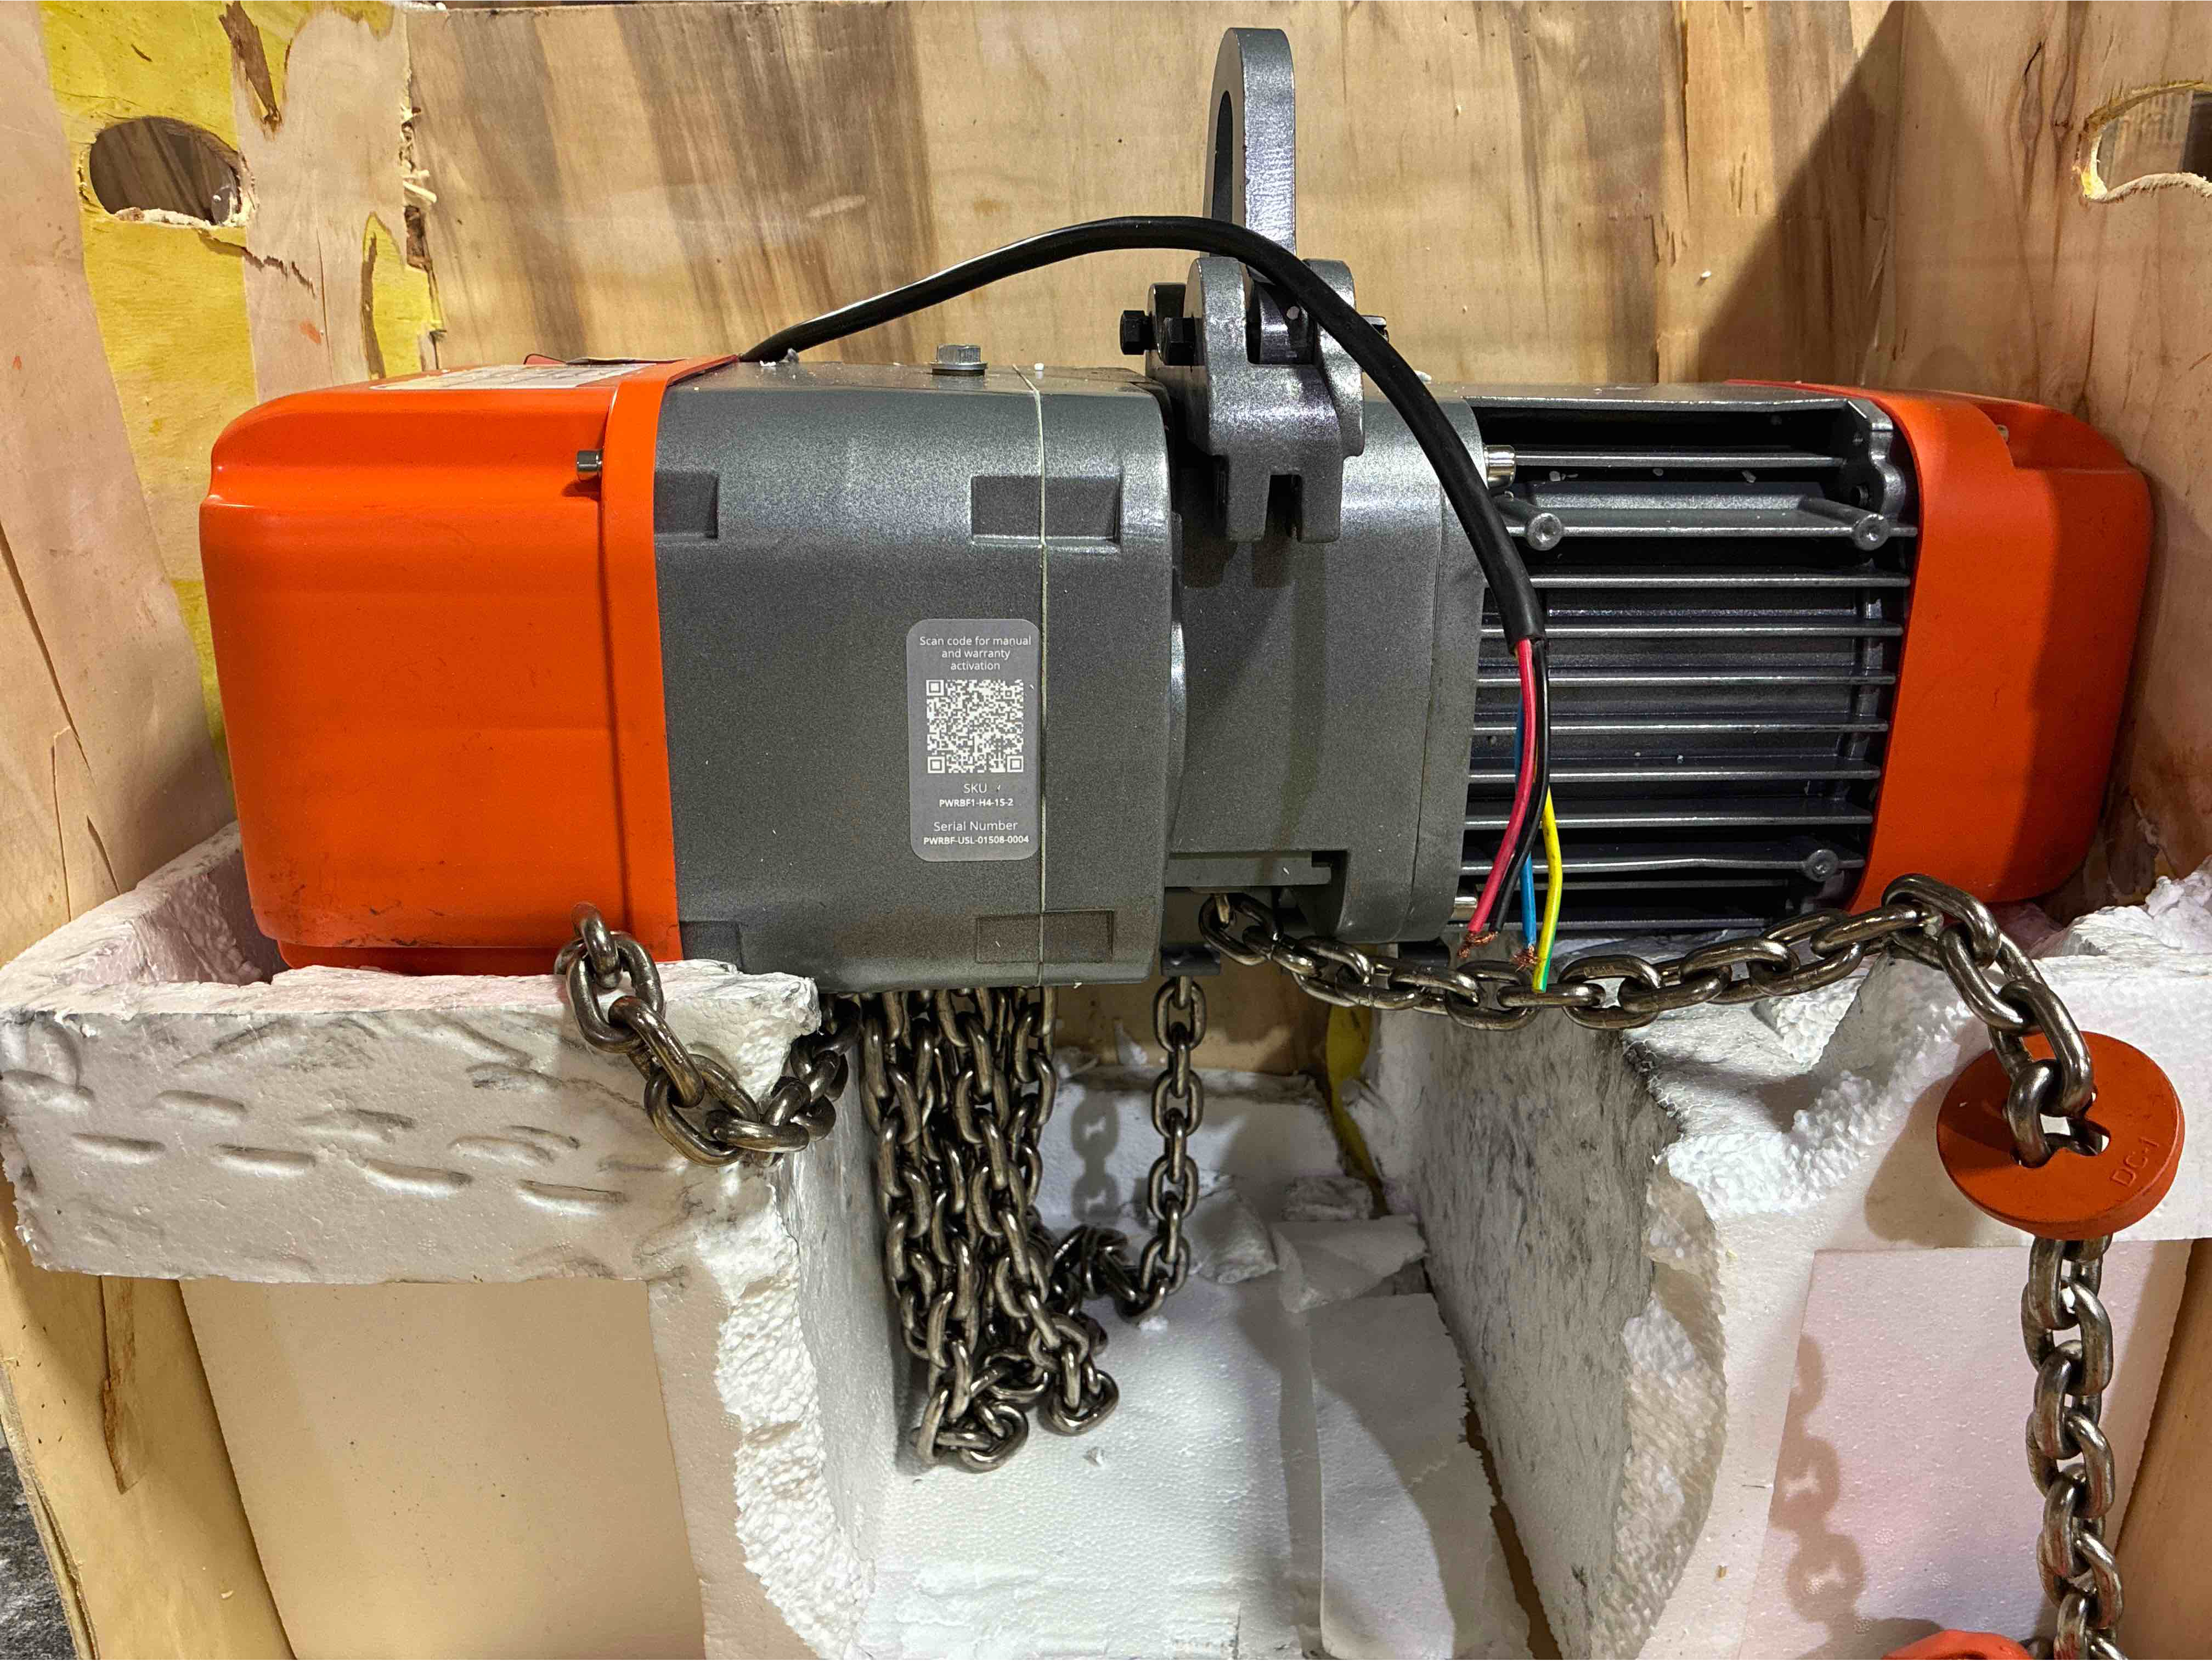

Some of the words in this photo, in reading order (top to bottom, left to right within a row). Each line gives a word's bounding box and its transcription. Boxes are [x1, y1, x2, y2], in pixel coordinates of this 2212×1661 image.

[919, 636, 944, 646] Scan
[947, 636, 972, 646] code
[975, 636, 990, 645] for
[993, 635, 1031, 646] manual
[941, 649, 961, 658] and
[964, 649, 1011, 660] warranty
[950, 661, 1000, 671] activation
[963, 783, 988, 793] SKU
[933, 821, 966, 831] Serial
[970, 820, 1018, 831] Number
